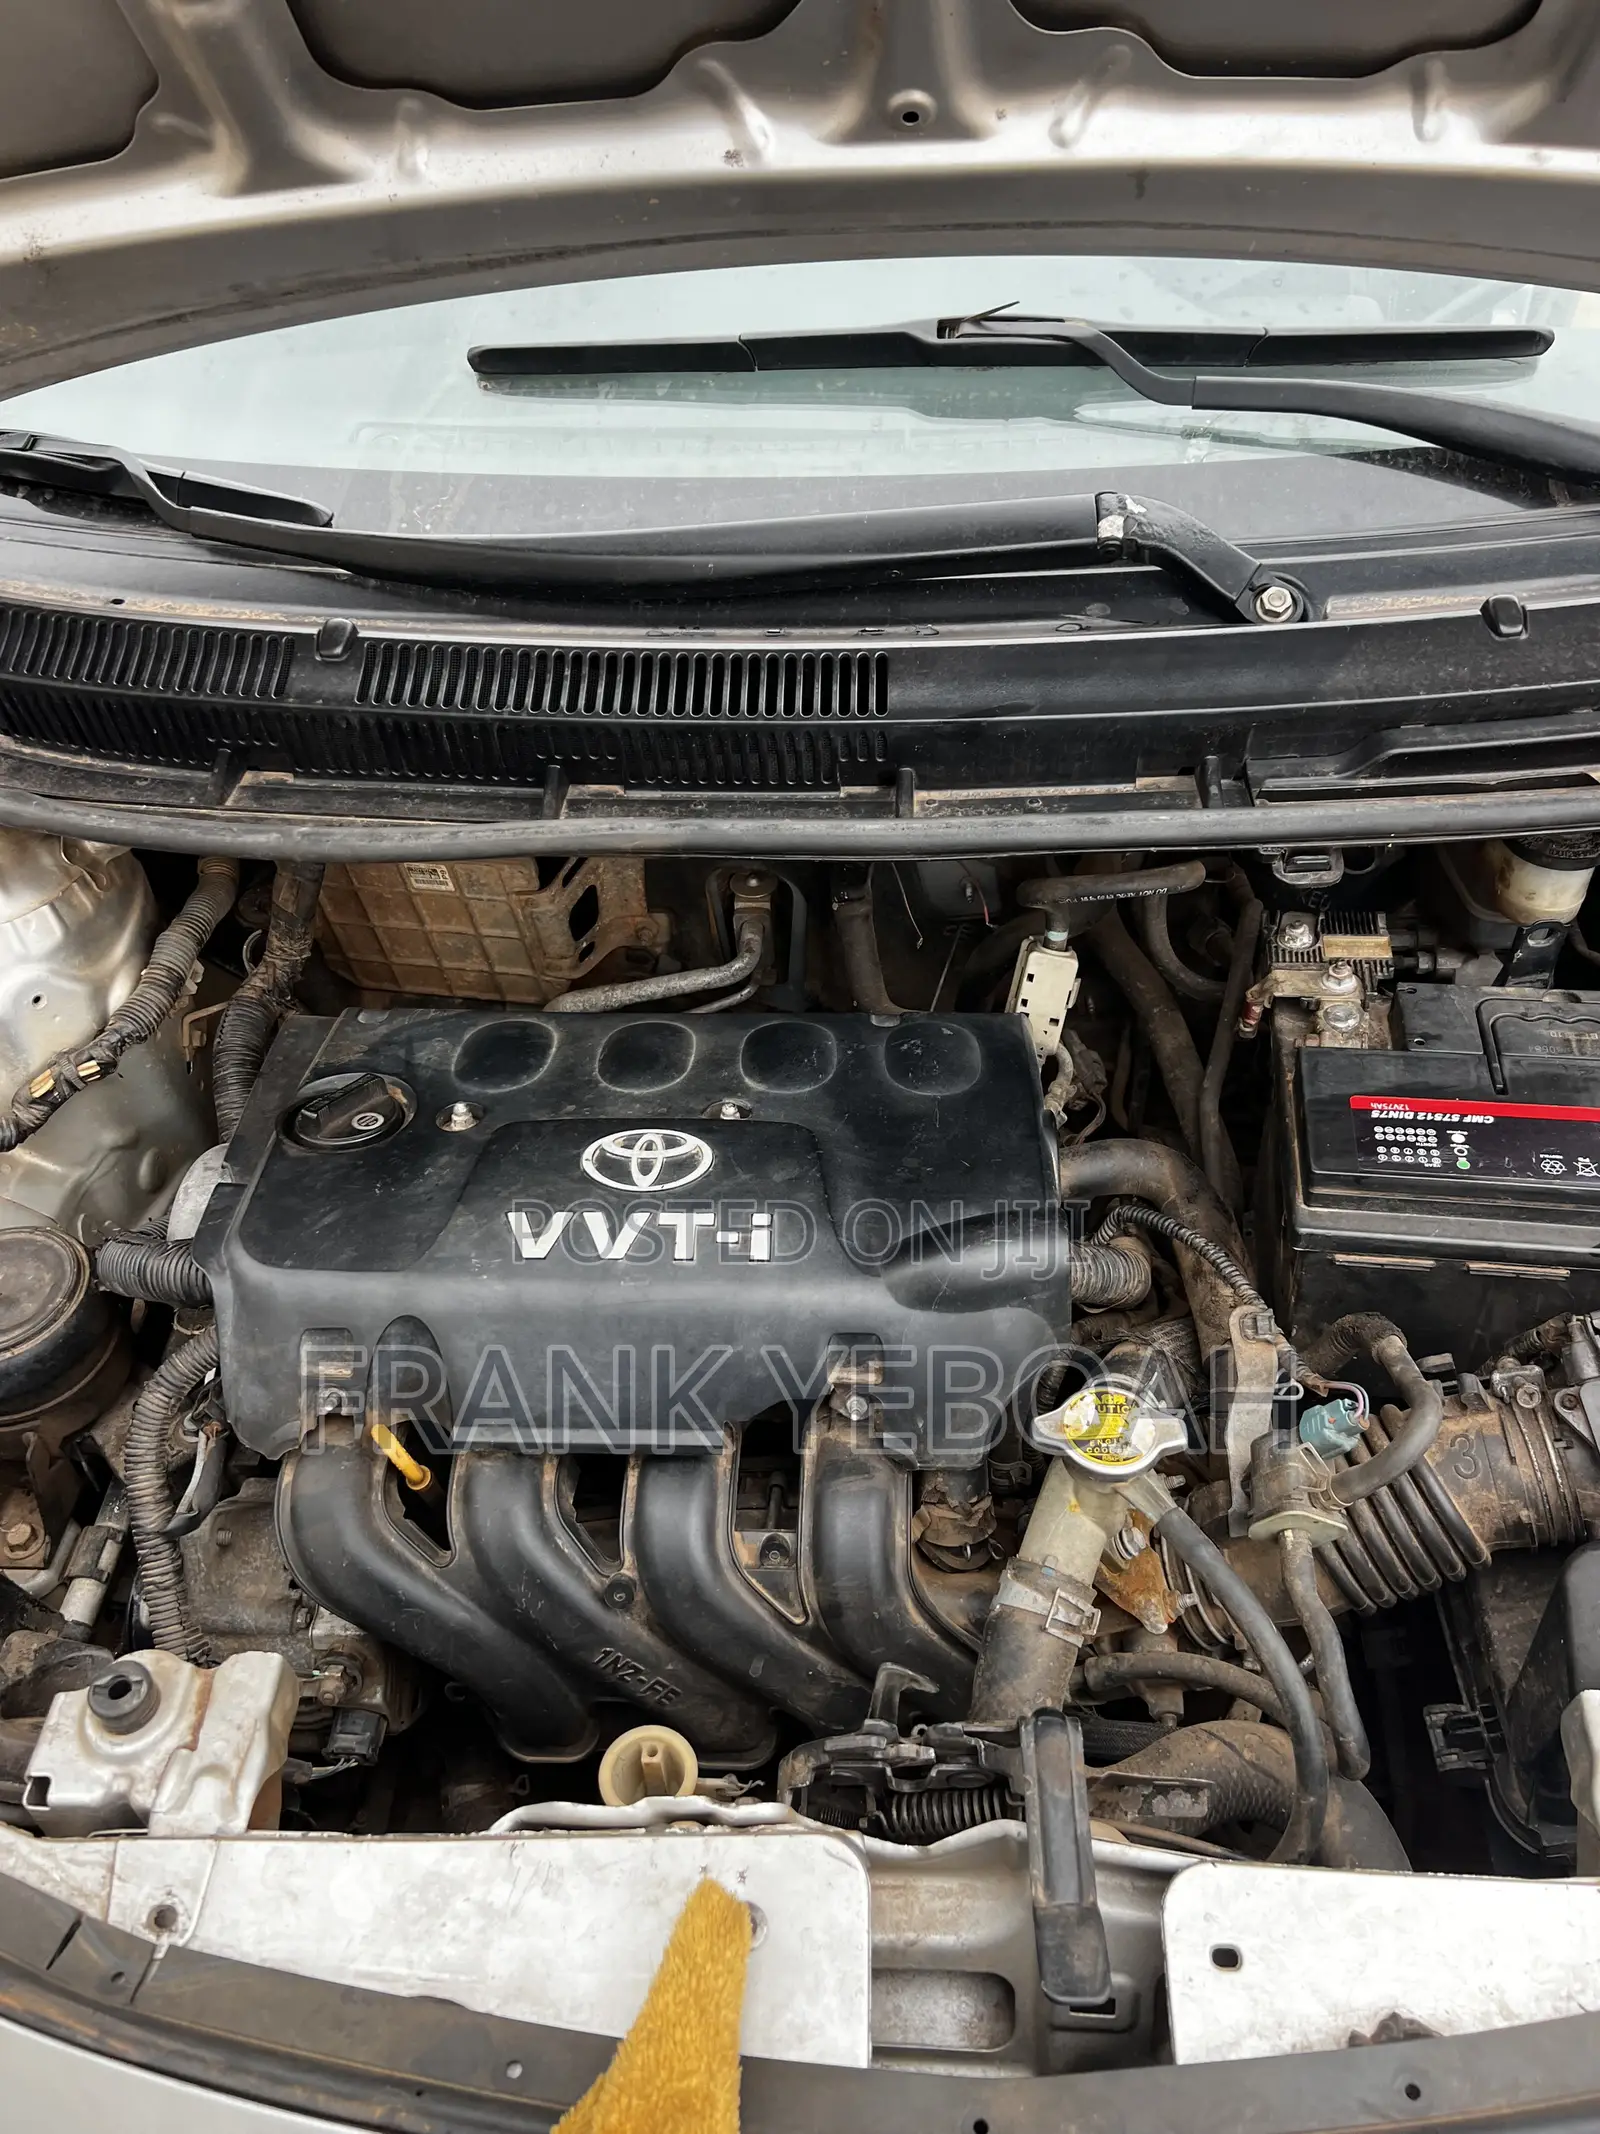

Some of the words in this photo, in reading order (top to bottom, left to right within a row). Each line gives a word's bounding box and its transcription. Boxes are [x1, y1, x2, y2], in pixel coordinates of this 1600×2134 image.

[1370, 1102, 1410, 1110] 12V75Ah
[1370, 1109, 1415, 1119] DIN75
[1417, 1111, 1461, 1123] 57512
[1463, 1114, 1495, 1124] CMF
[505, 1211, 773, 1262] VVT-i
[1449, 1432, 1482, 1480] 3
[592, 1647, 682, 1705] 1NZ-FE
